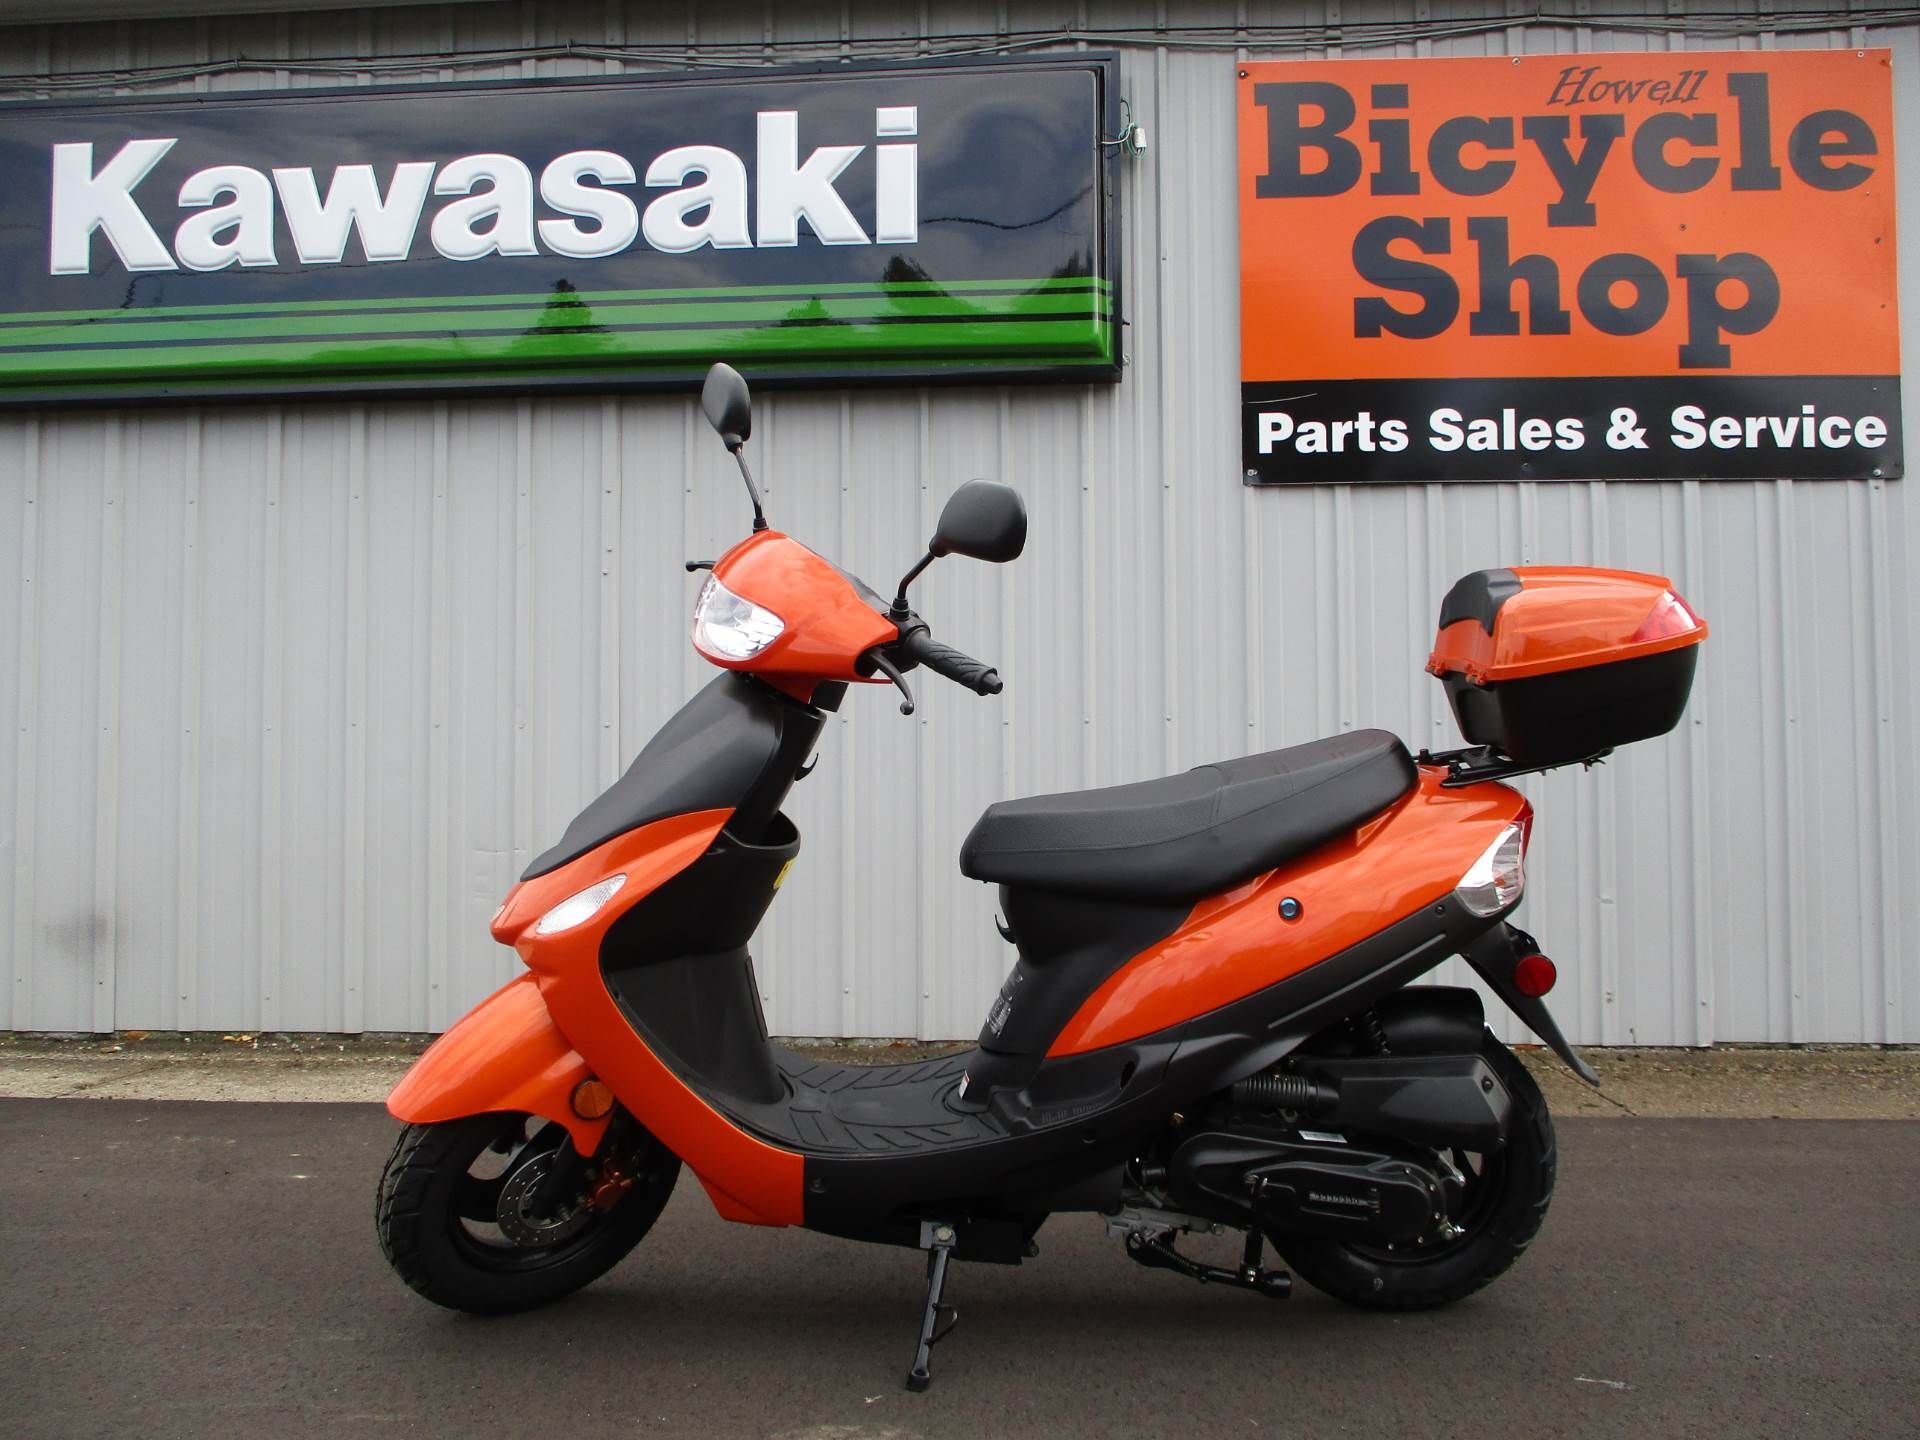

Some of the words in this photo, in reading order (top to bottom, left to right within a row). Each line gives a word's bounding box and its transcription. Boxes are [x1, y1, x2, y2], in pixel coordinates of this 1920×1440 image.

[1254, 72, 1878, 228] Bicycle
[1546, 66, 1709, 107] Howell
[50, 106, 918, 275] Kawasaki
[1352, 215, 1781, 370] Shop
[1258, 411, 1409, 454] Parts
[1429, 408, 1586, 451] Sales
[1605, 407, 1650, 450] &
[1670, 404, 1888, 449] Service
